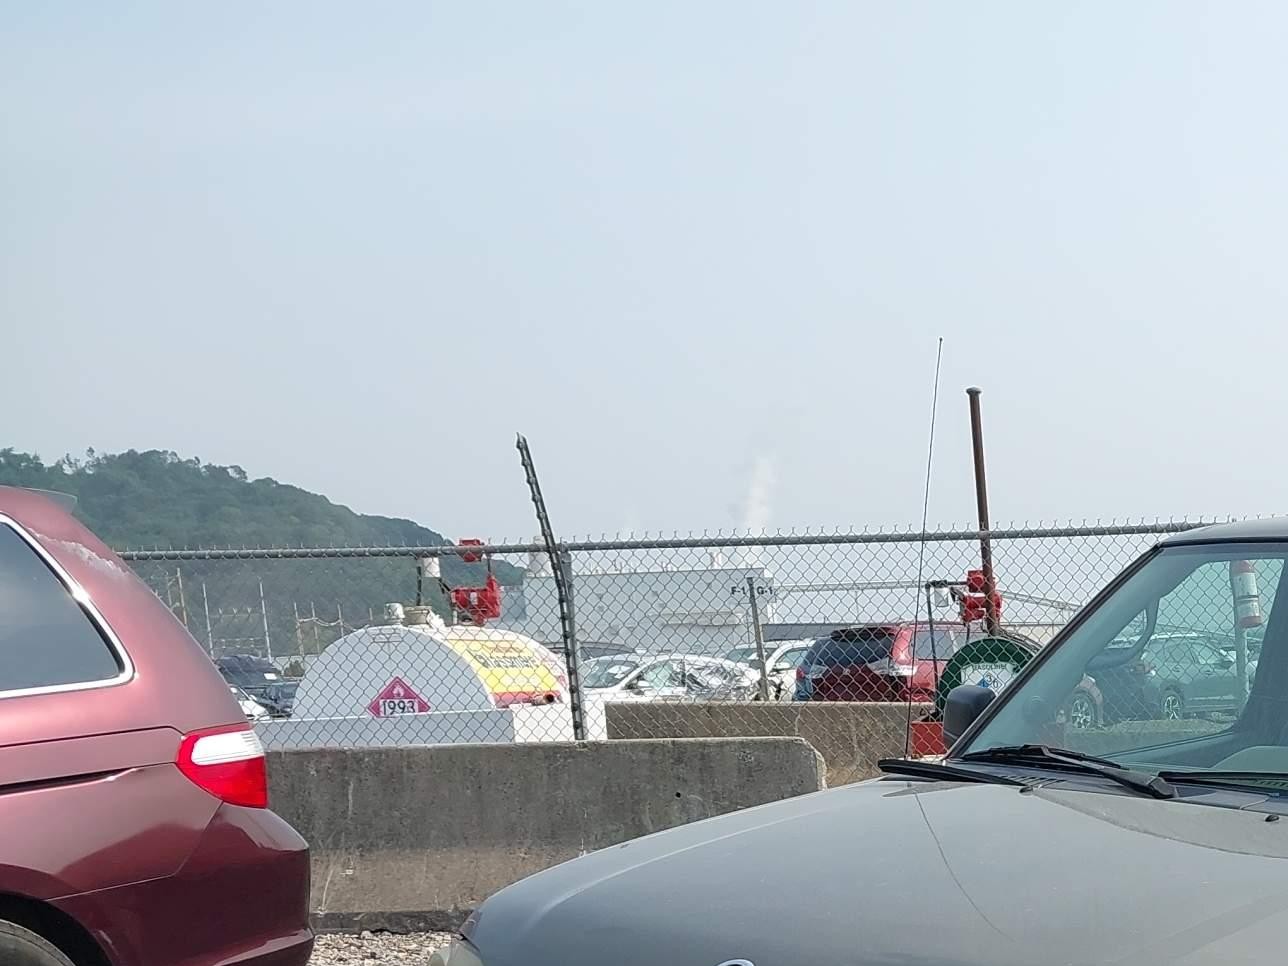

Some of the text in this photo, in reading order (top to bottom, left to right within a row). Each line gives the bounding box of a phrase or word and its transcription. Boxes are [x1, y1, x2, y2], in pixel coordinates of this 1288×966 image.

[731, 586, 746, 595] F-1
[757, 586, 773, 595] G-1
[383, 700, 415, 716] 1993
